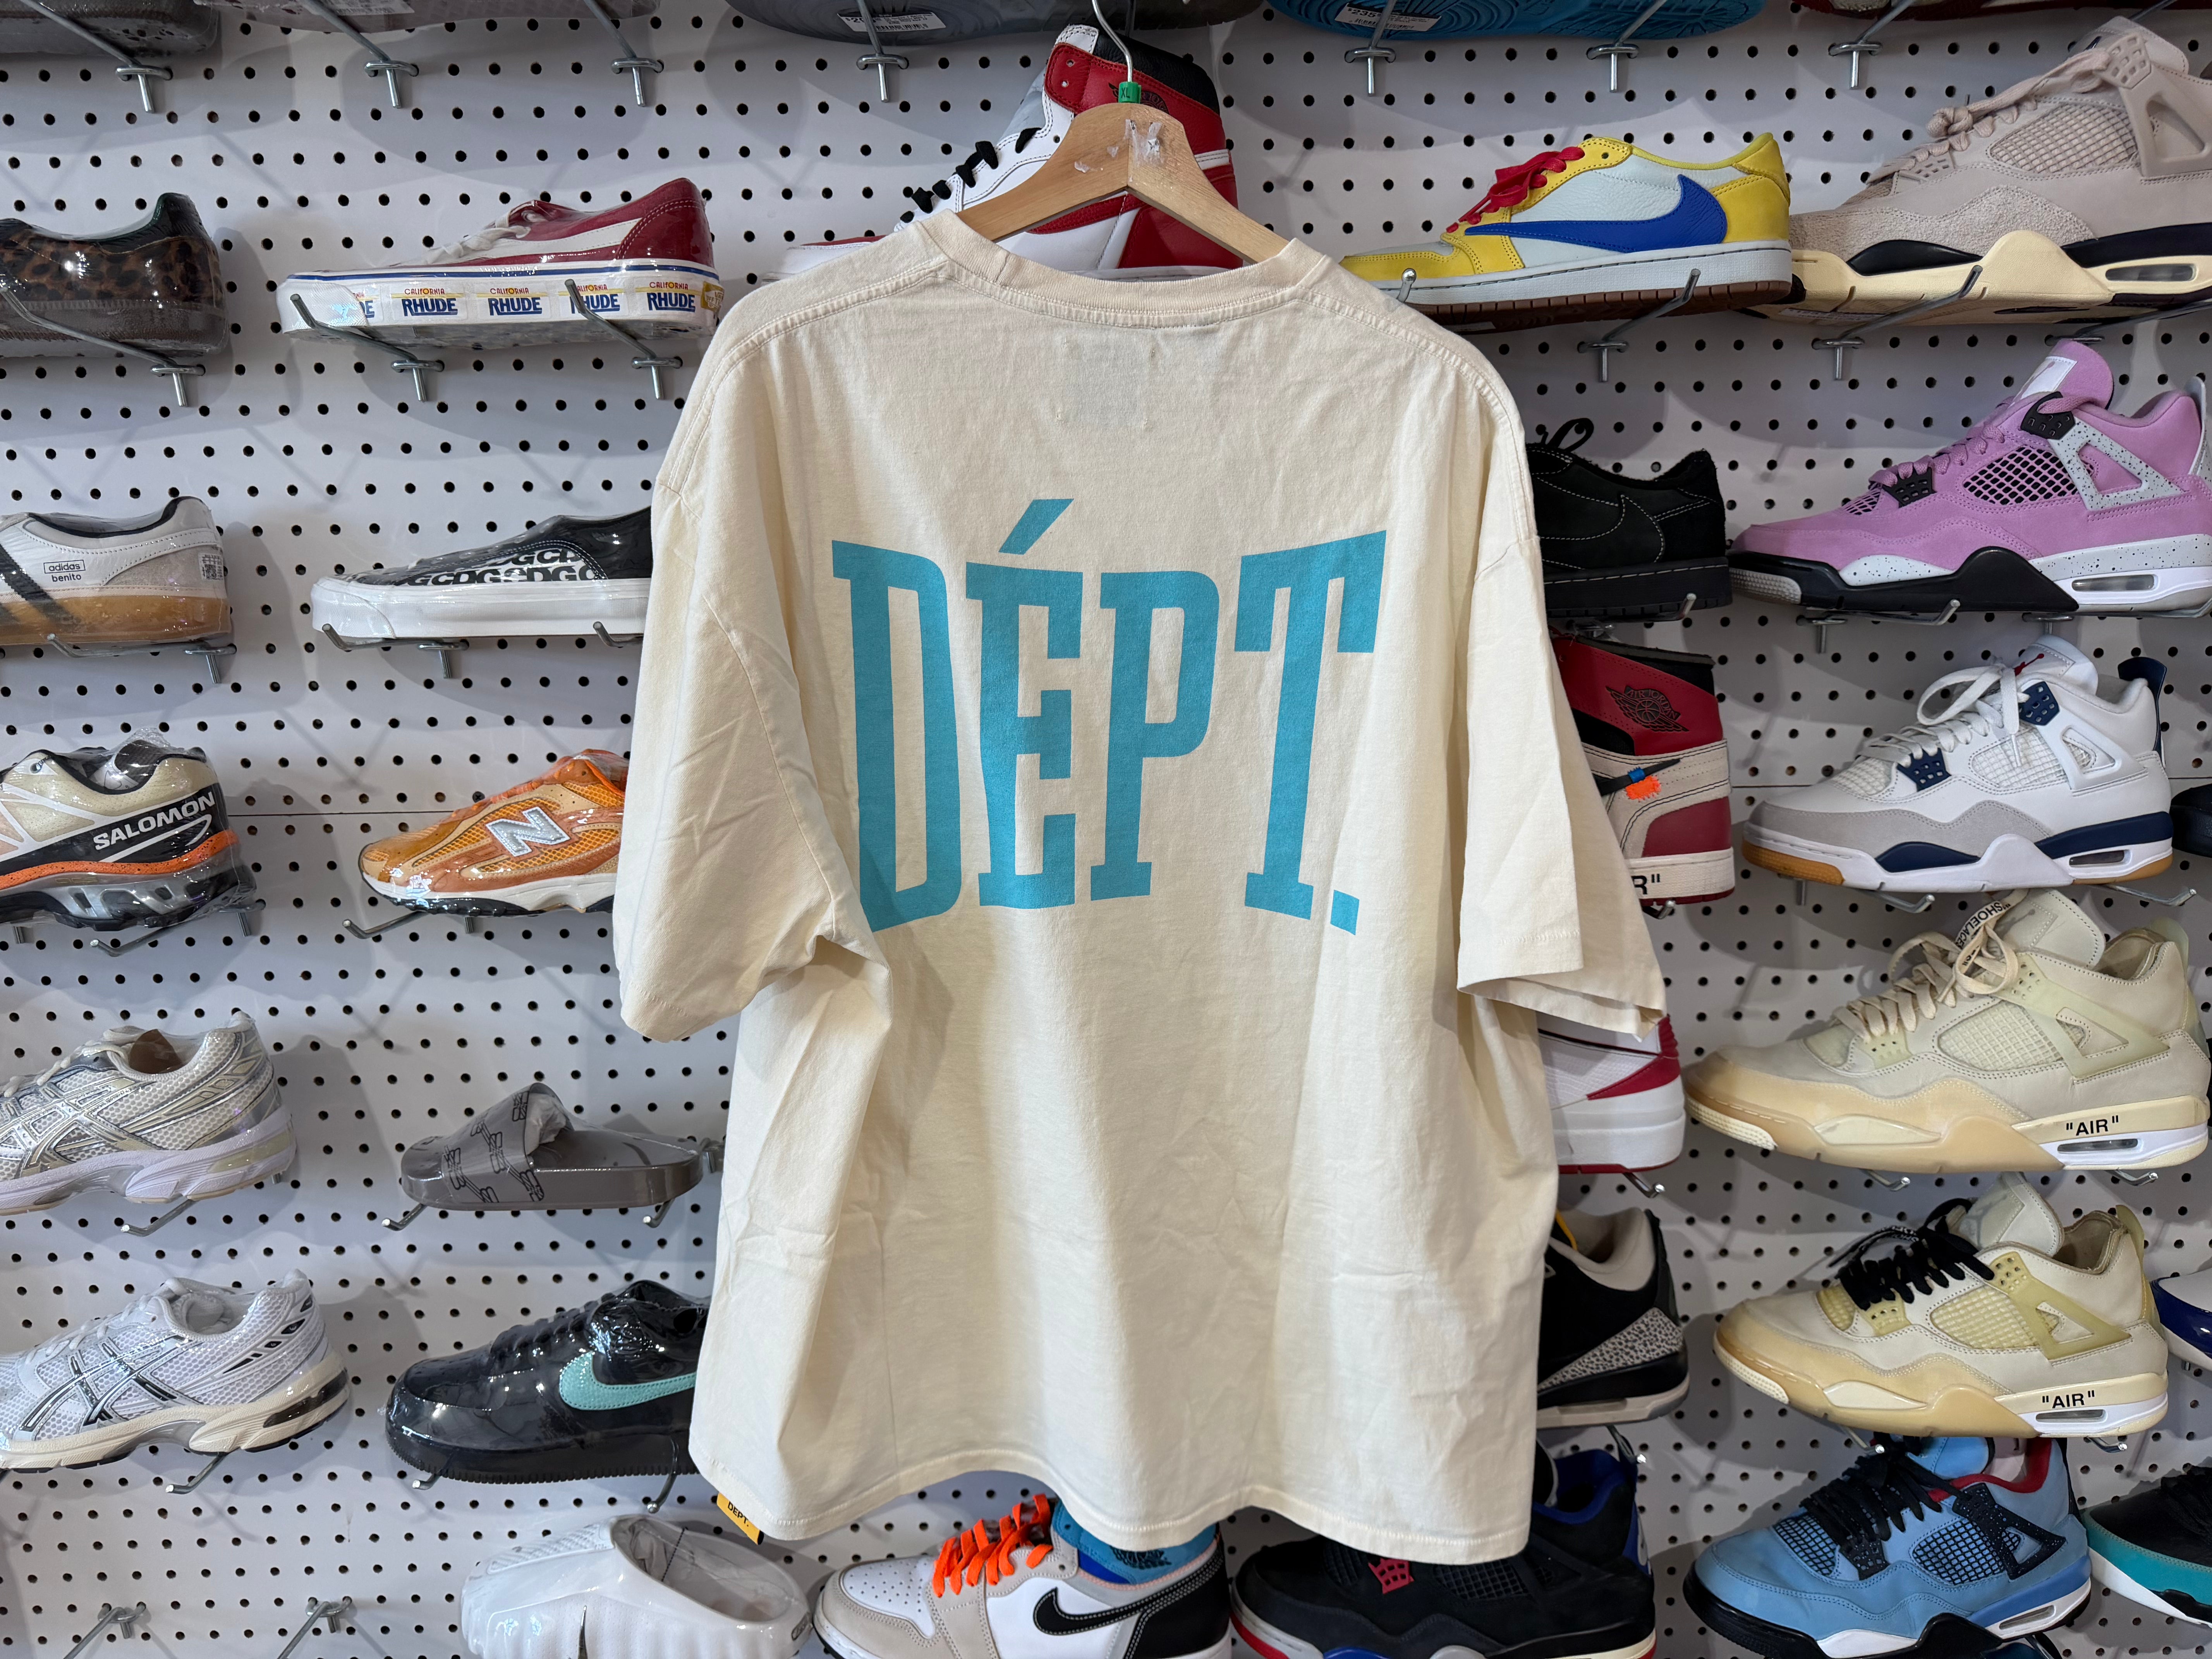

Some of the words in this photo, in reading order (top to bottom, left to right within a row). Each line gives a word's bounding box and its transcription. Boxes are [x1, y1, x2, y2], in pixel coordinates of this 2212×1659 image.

[1121, 87, 1130, 98] XL
[577, 284, 608, 292] ALIFORNIA
[650, 281, 688, 290] CALIFORNIA
[402, 298, 458, 316] RHUDE
[488, 297, 542, 316] RHUDE
[647, 292, 696, 313] RHUDE
[49, 563, 81, 572] adidas
[52, 573, 81, 582] benito
[1648, 689, 1678, 719] JORDAN
[832, 498, 1387, 936] DÉPT.
[93, 792, 215, 850] SALOMON
[2066, 1115, 2119, 1136] "AIR"
[2042, 1390, 2095, 1409] "AIR"
[728, 1501, 749, 1527] DEPT.
